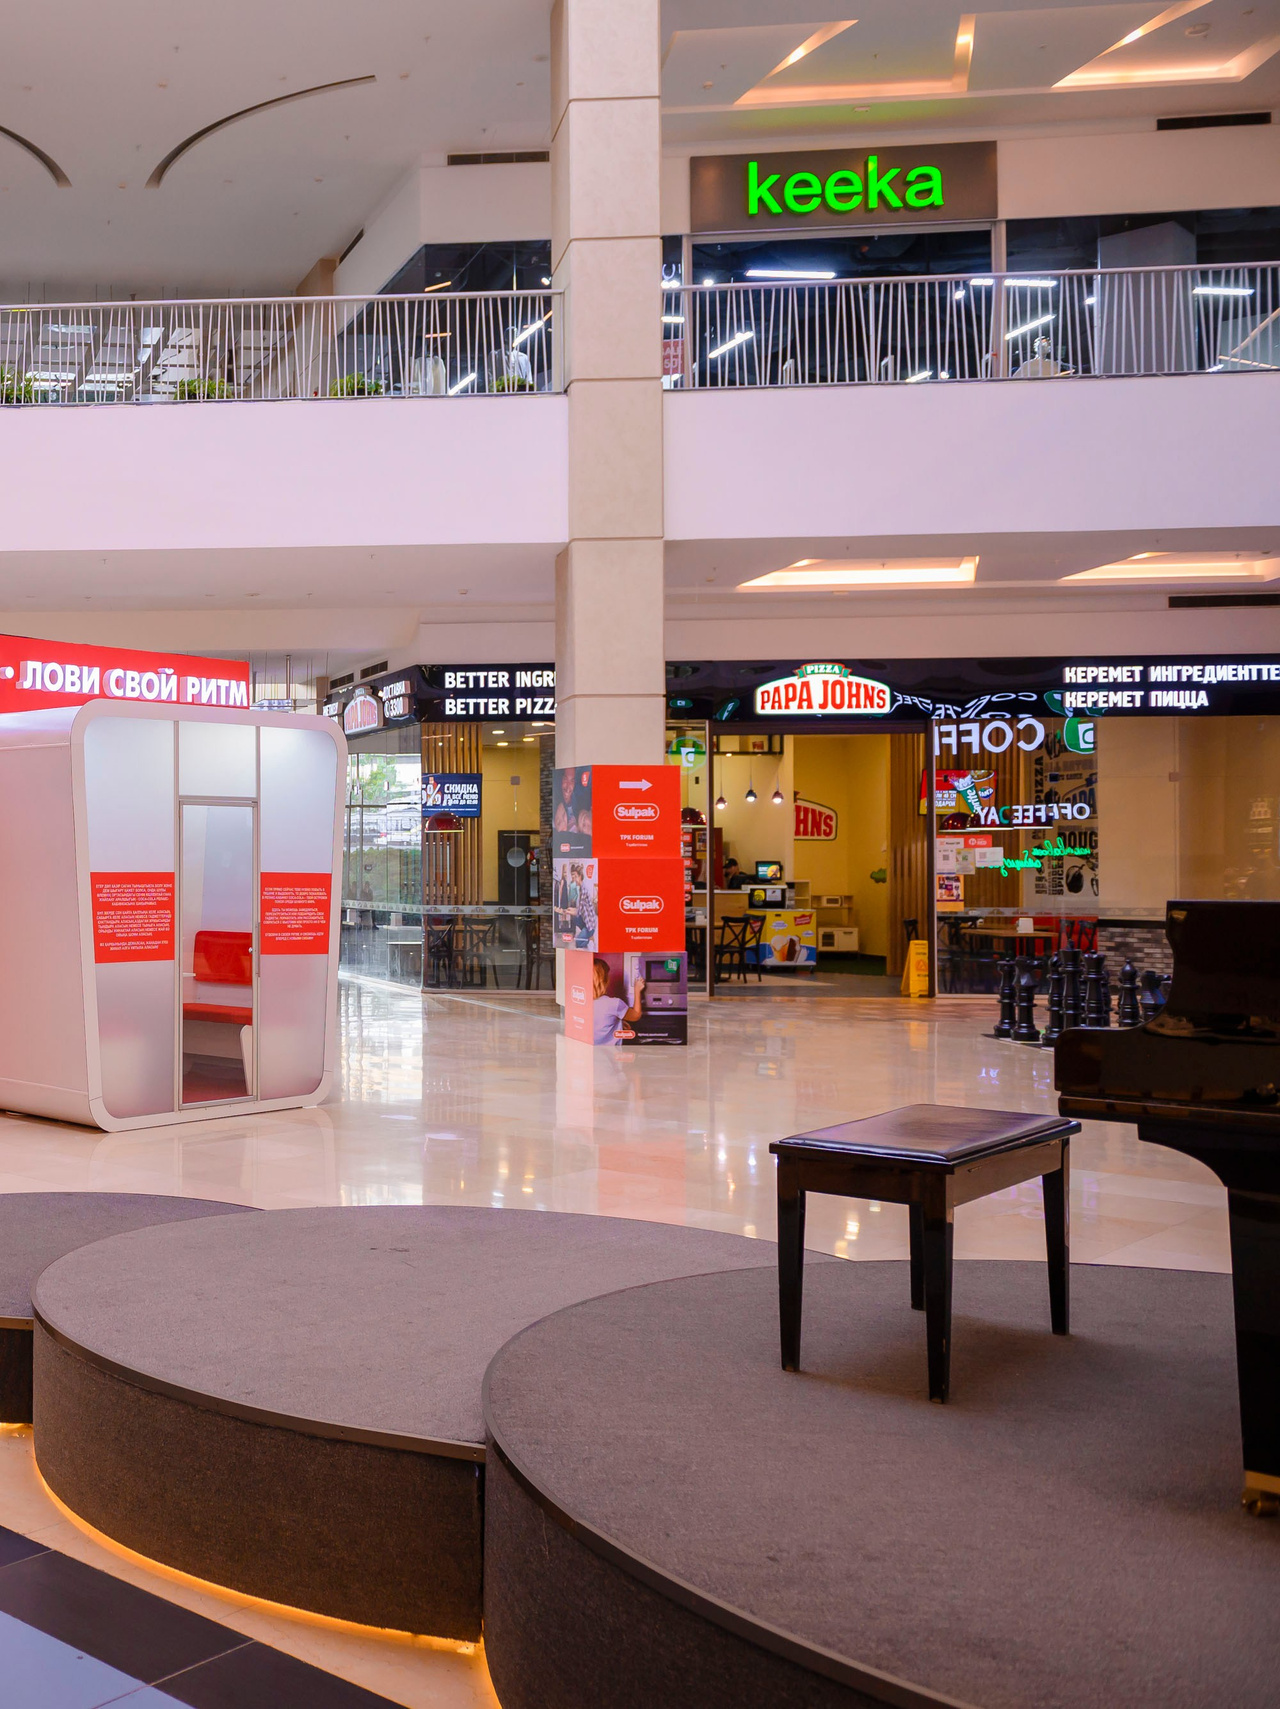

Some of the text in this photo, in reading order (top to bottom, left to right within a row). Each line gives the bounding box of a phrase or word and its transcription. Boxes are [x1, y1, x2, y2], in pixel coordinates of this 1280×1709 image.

[747, 154, 945, 216] keeka
[806, 665, 840, 674] PIZZA
[1063, 664, 1280, 684] КЕРЕМЕТ ИНГРЕДИЕНТТЕ
[20, 660, 101, 696] ЛОВИ
[107, 668, 178, 702] СВОЙ
[186, 675, 249, 707] РИТМ
[444, 670, 556, 689] BETTER INGR
[760, 680, 814, 711] PAPA
[818, 679, 887, 710] JOHN'S
[1063, 690, 1209, 709] КЕРЕМЕТ ПИЦЦА
[444, 697, 557, 715] BETTER PIZZ
[444, 783, 478, 794] СКИДКА
[617, 806, 656, 820] Sulpak
[622, 899, 660, 912] Sulpak
